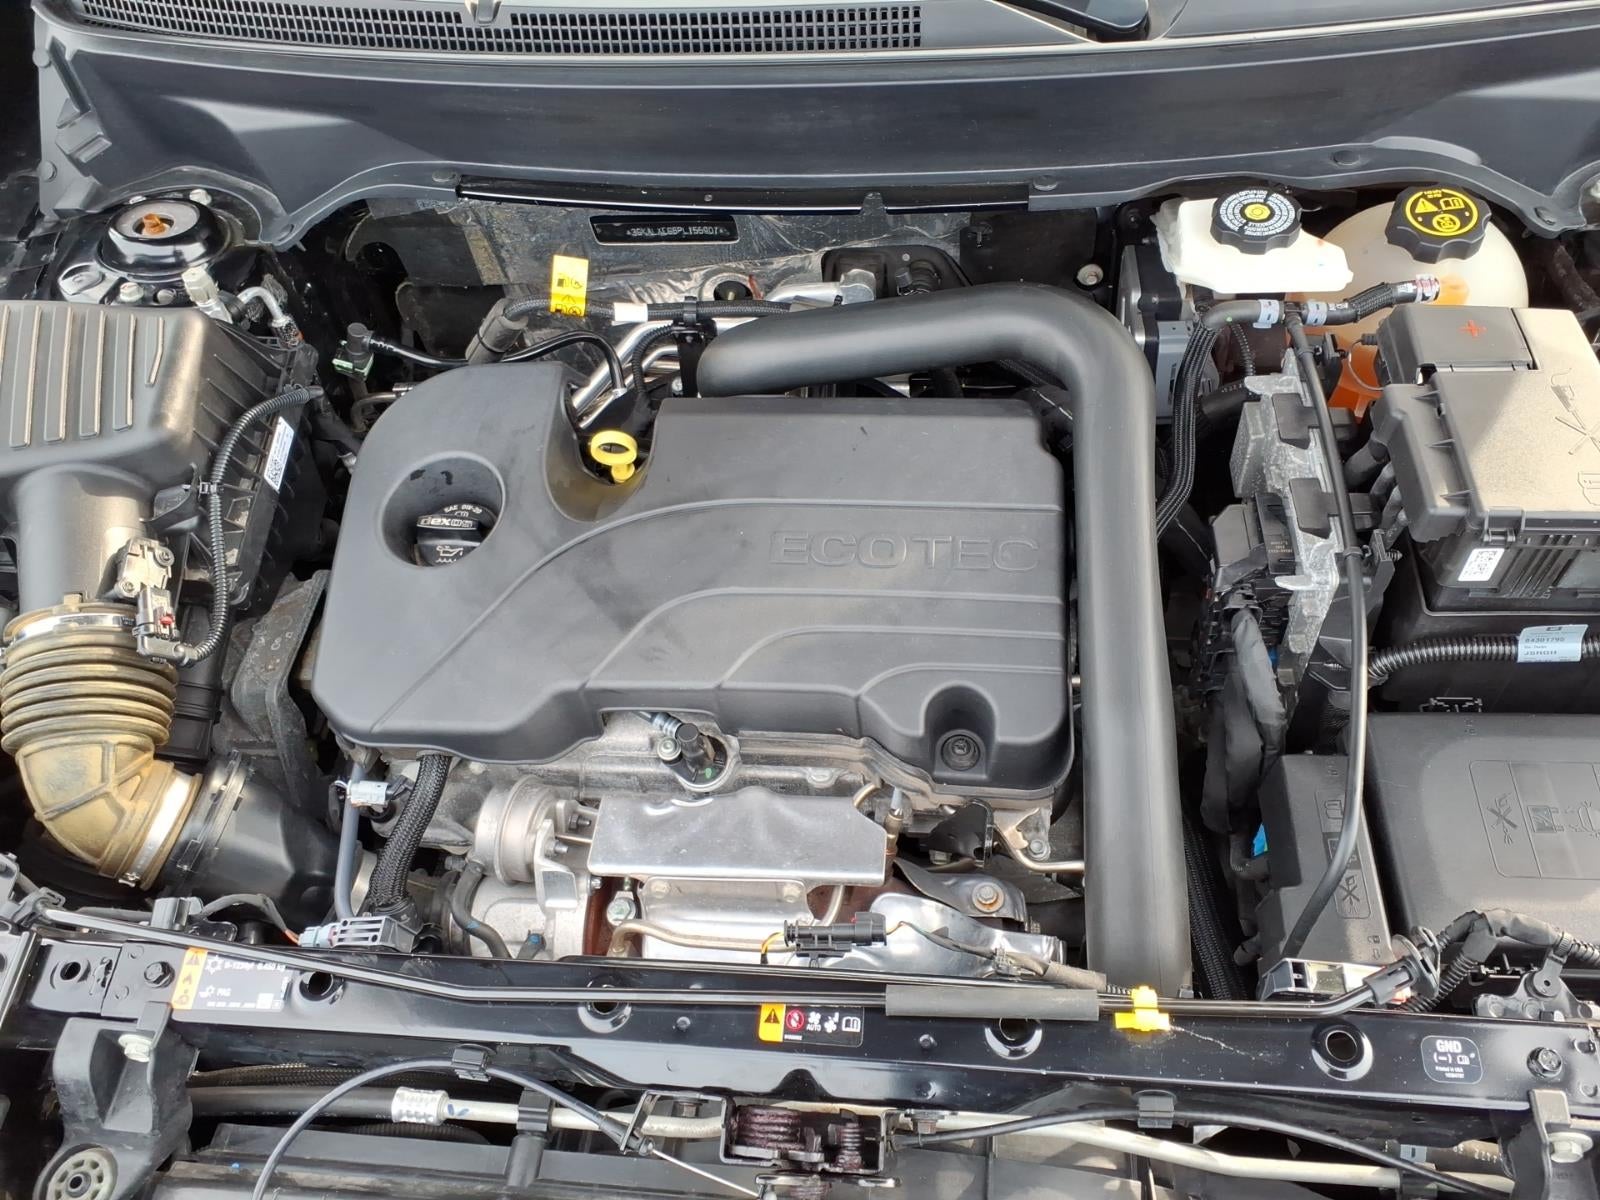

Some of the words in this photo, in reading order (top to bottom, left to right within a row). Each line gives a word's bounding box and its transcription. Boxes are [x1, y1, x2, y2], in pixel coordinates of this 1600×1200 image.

[444, 504, 458, 513] SAE
[769, 530, 1040, 573] ECOTEC
[806, 1024, 821, 1032] AUTO
[1436, 1039, 1462, 1053] GND
